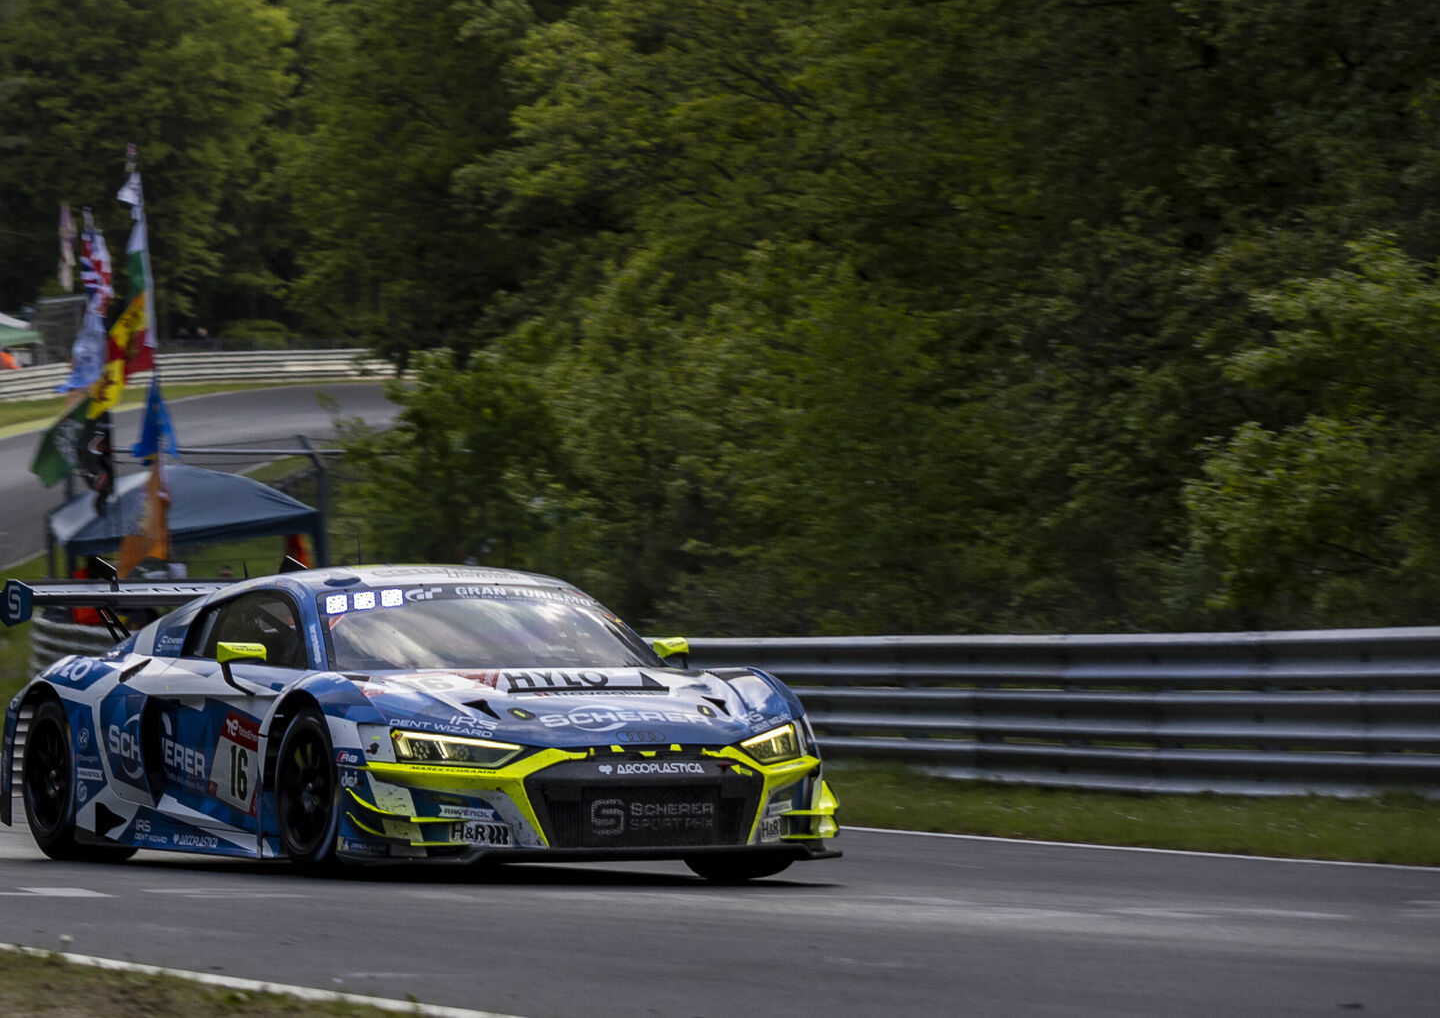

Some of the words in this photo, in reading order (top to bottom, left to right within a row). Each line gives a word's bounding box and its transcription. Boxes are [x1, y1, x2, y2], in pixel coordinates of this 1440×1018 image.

[454, 586, 507, 597] GRAN
[513, 588, 592, 607] TURISMO
[502, 670, 609, 690] HYLO
[389, 718, 432, 730] DENT
[434, 723, 493, 738] WIZARD
[449, 715, 499, 731] IRS
[540, 711, 713, 728] SCHERER
[230, 744, 249, 802] 16
[445, 767, 497, 775] SCHRAMM
[616, 763, 705, 775] ARCOPLASTICA
[630, 802, 714, 816] SCHERER
[135, 818, 152, 831] IRS
[452, 822, 486, 841] H&R
